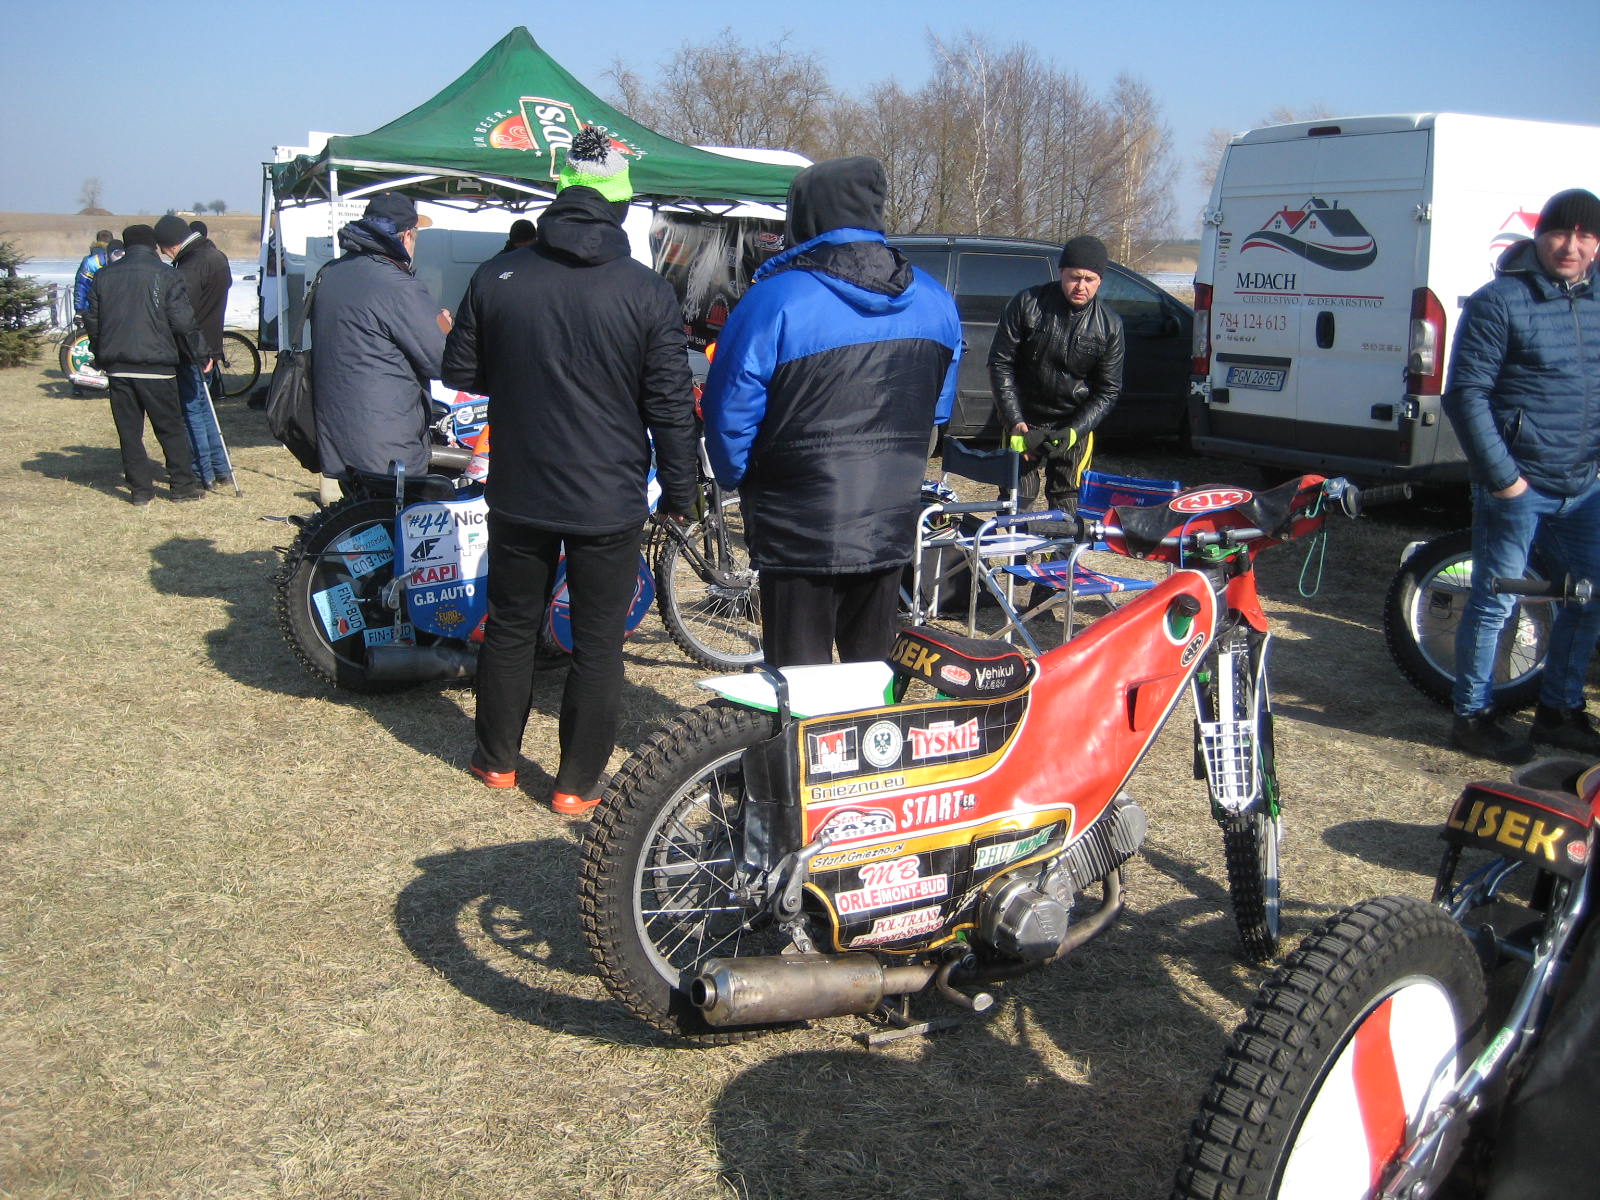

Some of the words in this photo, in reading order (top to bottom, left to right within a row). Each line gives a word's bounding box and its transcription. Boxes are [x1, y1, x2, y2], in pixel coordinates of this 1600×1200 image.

[475, 111, 507, 133] BEER
[1236, 272, 1296, 291] M-DACH
[1242, 294, 1299, 304] CIESIELSTWO
[1316, 297, 1382, 309] DEKARSTWO
[1219, 312, 1239, 329] 784
[1243, 313, 1262, 329] 124
[1265, 314, 1287, 331] 613
[1232, 369, 1251, 384] PGN
[1251, 371, 1283, 387] 269EY
[408, 509, 449, 536] #44
[412, 564, 458, 585] KAPI
[440, 583, 475, 602] AUTO
[910, 720, 978, 756] TYSKIE
[810, 776, 906, 800] Gniezno.eu
[900, 789, 965, 828] START
[823, 817, 887, 834] TAXI
[1447, 798, 1565, 862] LISEK
